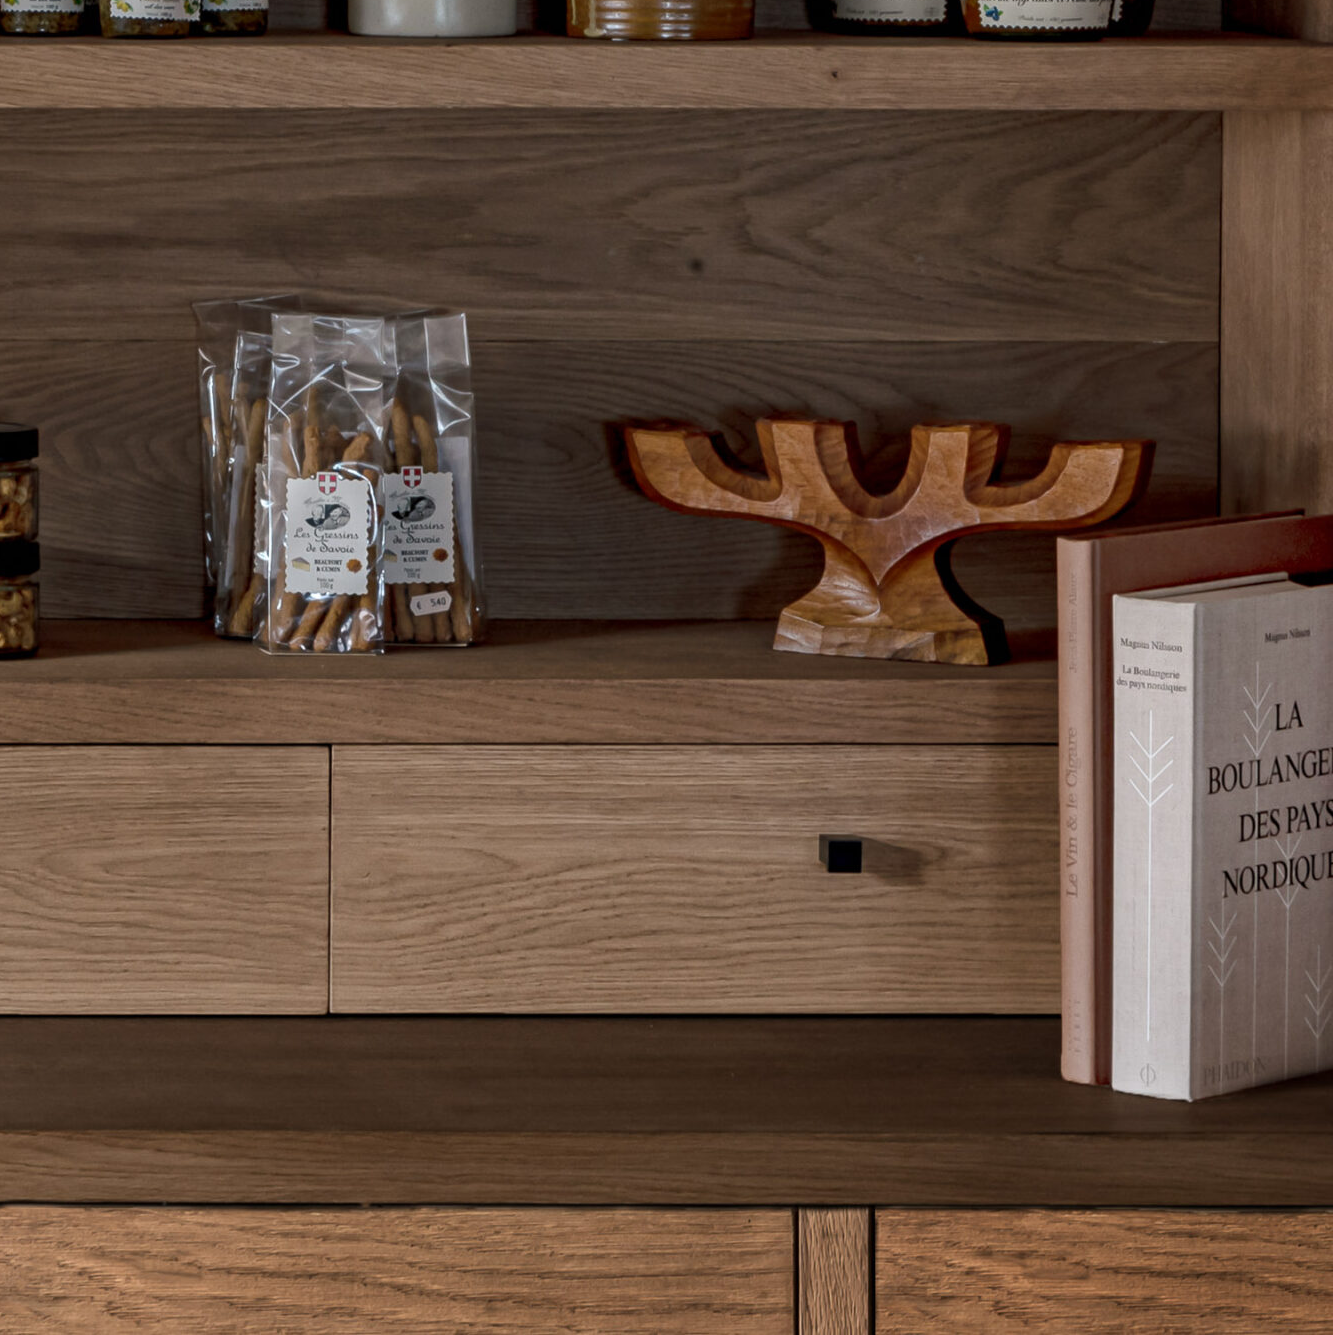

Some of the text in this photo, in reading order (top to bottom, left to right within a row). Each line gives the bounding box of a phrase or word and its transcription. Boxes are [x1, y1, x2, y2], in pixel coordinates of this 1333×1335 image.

[294, 525, 359, 543] Les Gressins
[400, 520, 445, 534] Gressins
[393, 533, 441, 544] de Savoie
[306, 541, 355, 553] de Savoie
[1265, 628, 1311, 644] Magnus Nilsson
[1120, 637, 1183, 653] Magnus Nilsson
[1122, 665, 1180, 680] La Boulangerie
[1116, 677, 1187, 694] des pays nordiques
[1275, 700, 1303, 731] LA
[1207, 747, 1333, 795] BOULANGE
[1065, 727, 1081, 899] Le Vin & le Cigare
[1239, 799, 1333, 843] DES PAYS
